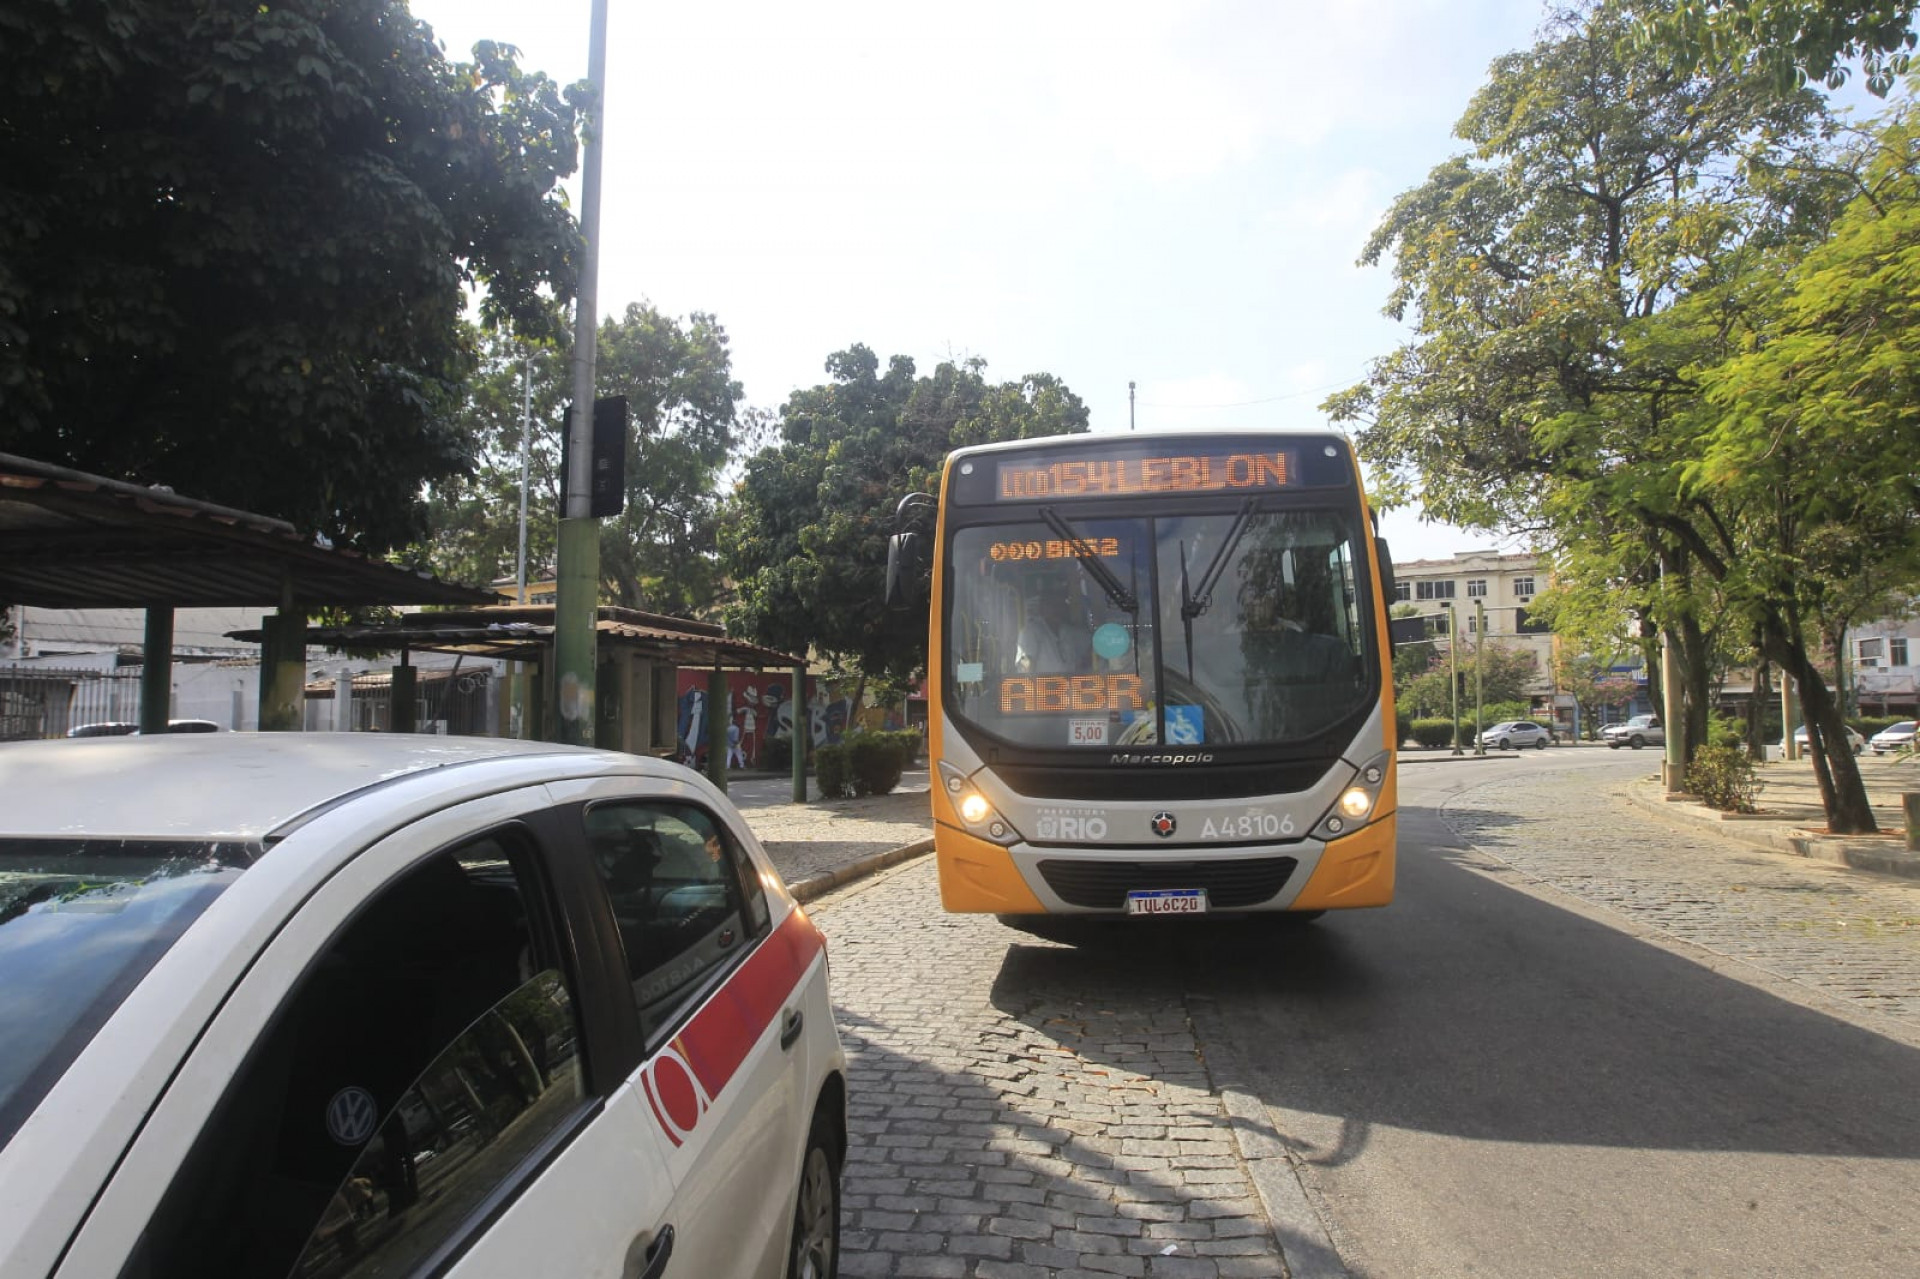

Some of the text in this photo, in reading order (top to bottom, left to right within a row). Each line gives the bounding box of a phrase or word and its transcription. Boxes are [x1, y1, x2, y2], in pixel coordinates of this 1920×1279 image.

[1117, 451, 1288, 493] LEBLON
[1000, 673, 1143, 713] ABBR
[1074, 726, 1103, 742] 5,00
[1110, 752, 1214, 765] Marcopolo
[1060, 817, 1107, 840] RIO
[1200, 813, 1295, 838] A48106
[1135, 897, 1198, 913] TUL6C20
